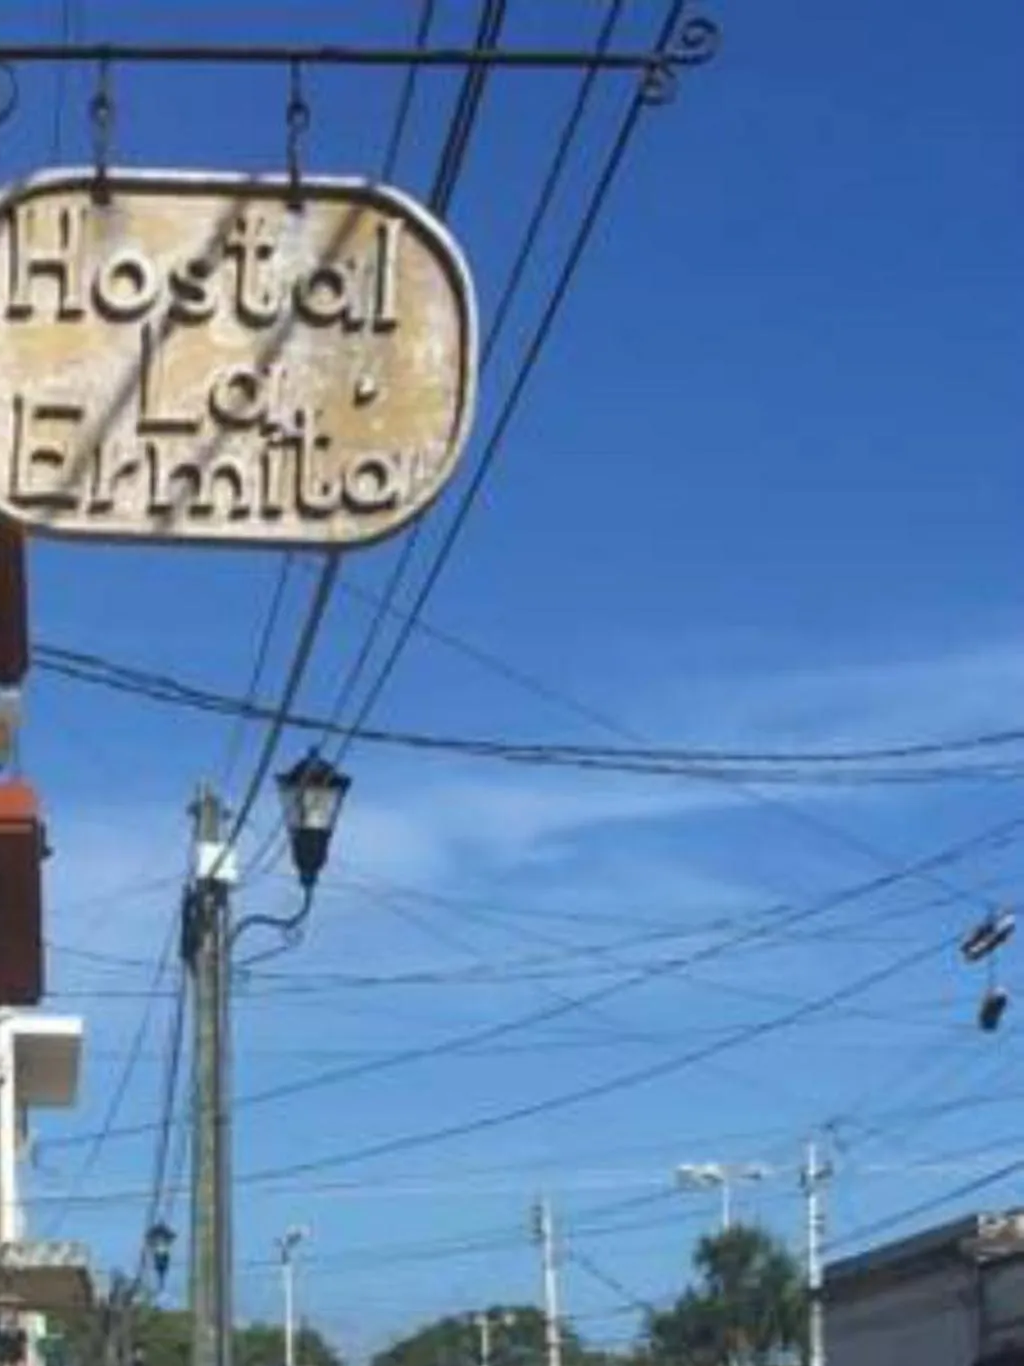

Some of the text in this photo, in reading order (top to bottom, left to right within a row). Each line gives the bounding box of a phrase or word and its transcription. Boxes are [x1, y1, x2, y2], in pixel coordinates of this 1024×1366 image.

[5, 207, 403, 332] Hostal
[138, 322, 290, 438] La
[8, 393, 413, 520] Ermita
